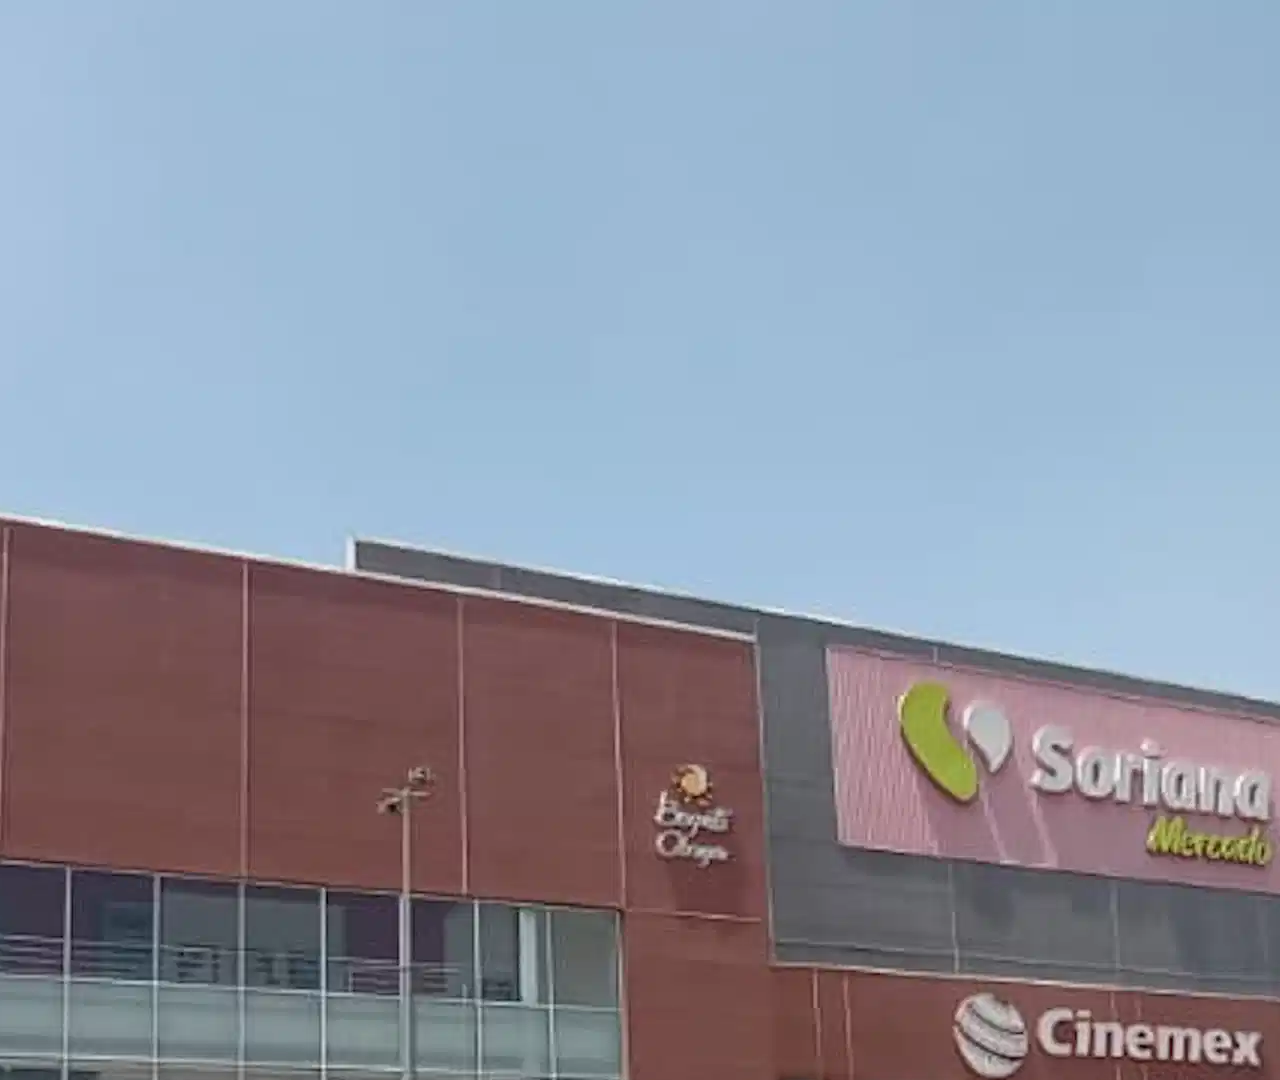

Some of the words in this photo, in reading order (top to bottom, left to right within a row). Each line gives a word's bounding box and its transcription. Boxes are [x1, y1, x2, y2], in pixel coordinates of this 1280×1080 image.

[1030, 724, 1271, 820] Soriana
[1146, 815, 1274, 866] Mercado
[1037, 1007, 1263, 1066] Cinemex
